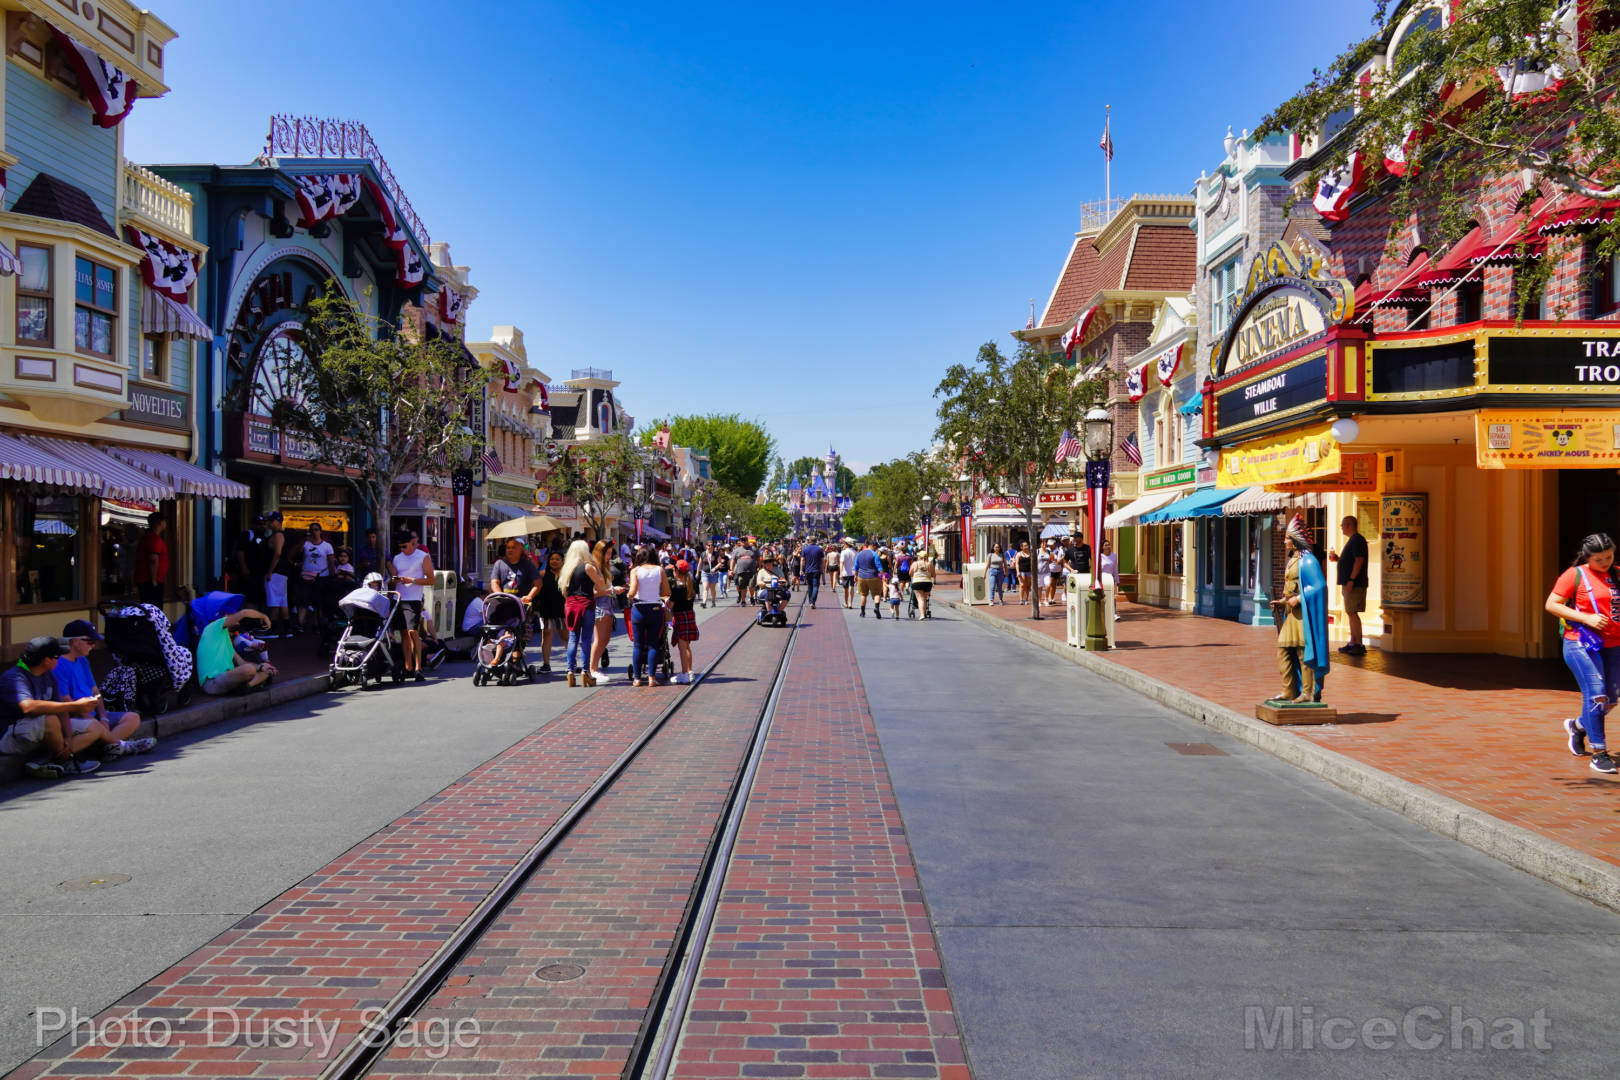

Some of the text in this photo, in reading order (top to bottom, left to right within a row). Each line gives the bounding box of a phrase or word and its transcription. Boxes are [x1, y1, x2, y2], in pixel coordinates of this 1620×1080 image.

[1236, 301, 1309, 364] CINEMA
[1575, 366, 1620, 381] TRO
[1244, 373, 1286, 400] STEAMBOAT
[132, 392, 182, 418] NOVELTIES
[1254, 397, 1277, 416] WILLIE
[1049, 494, 1066, 502] TEA
